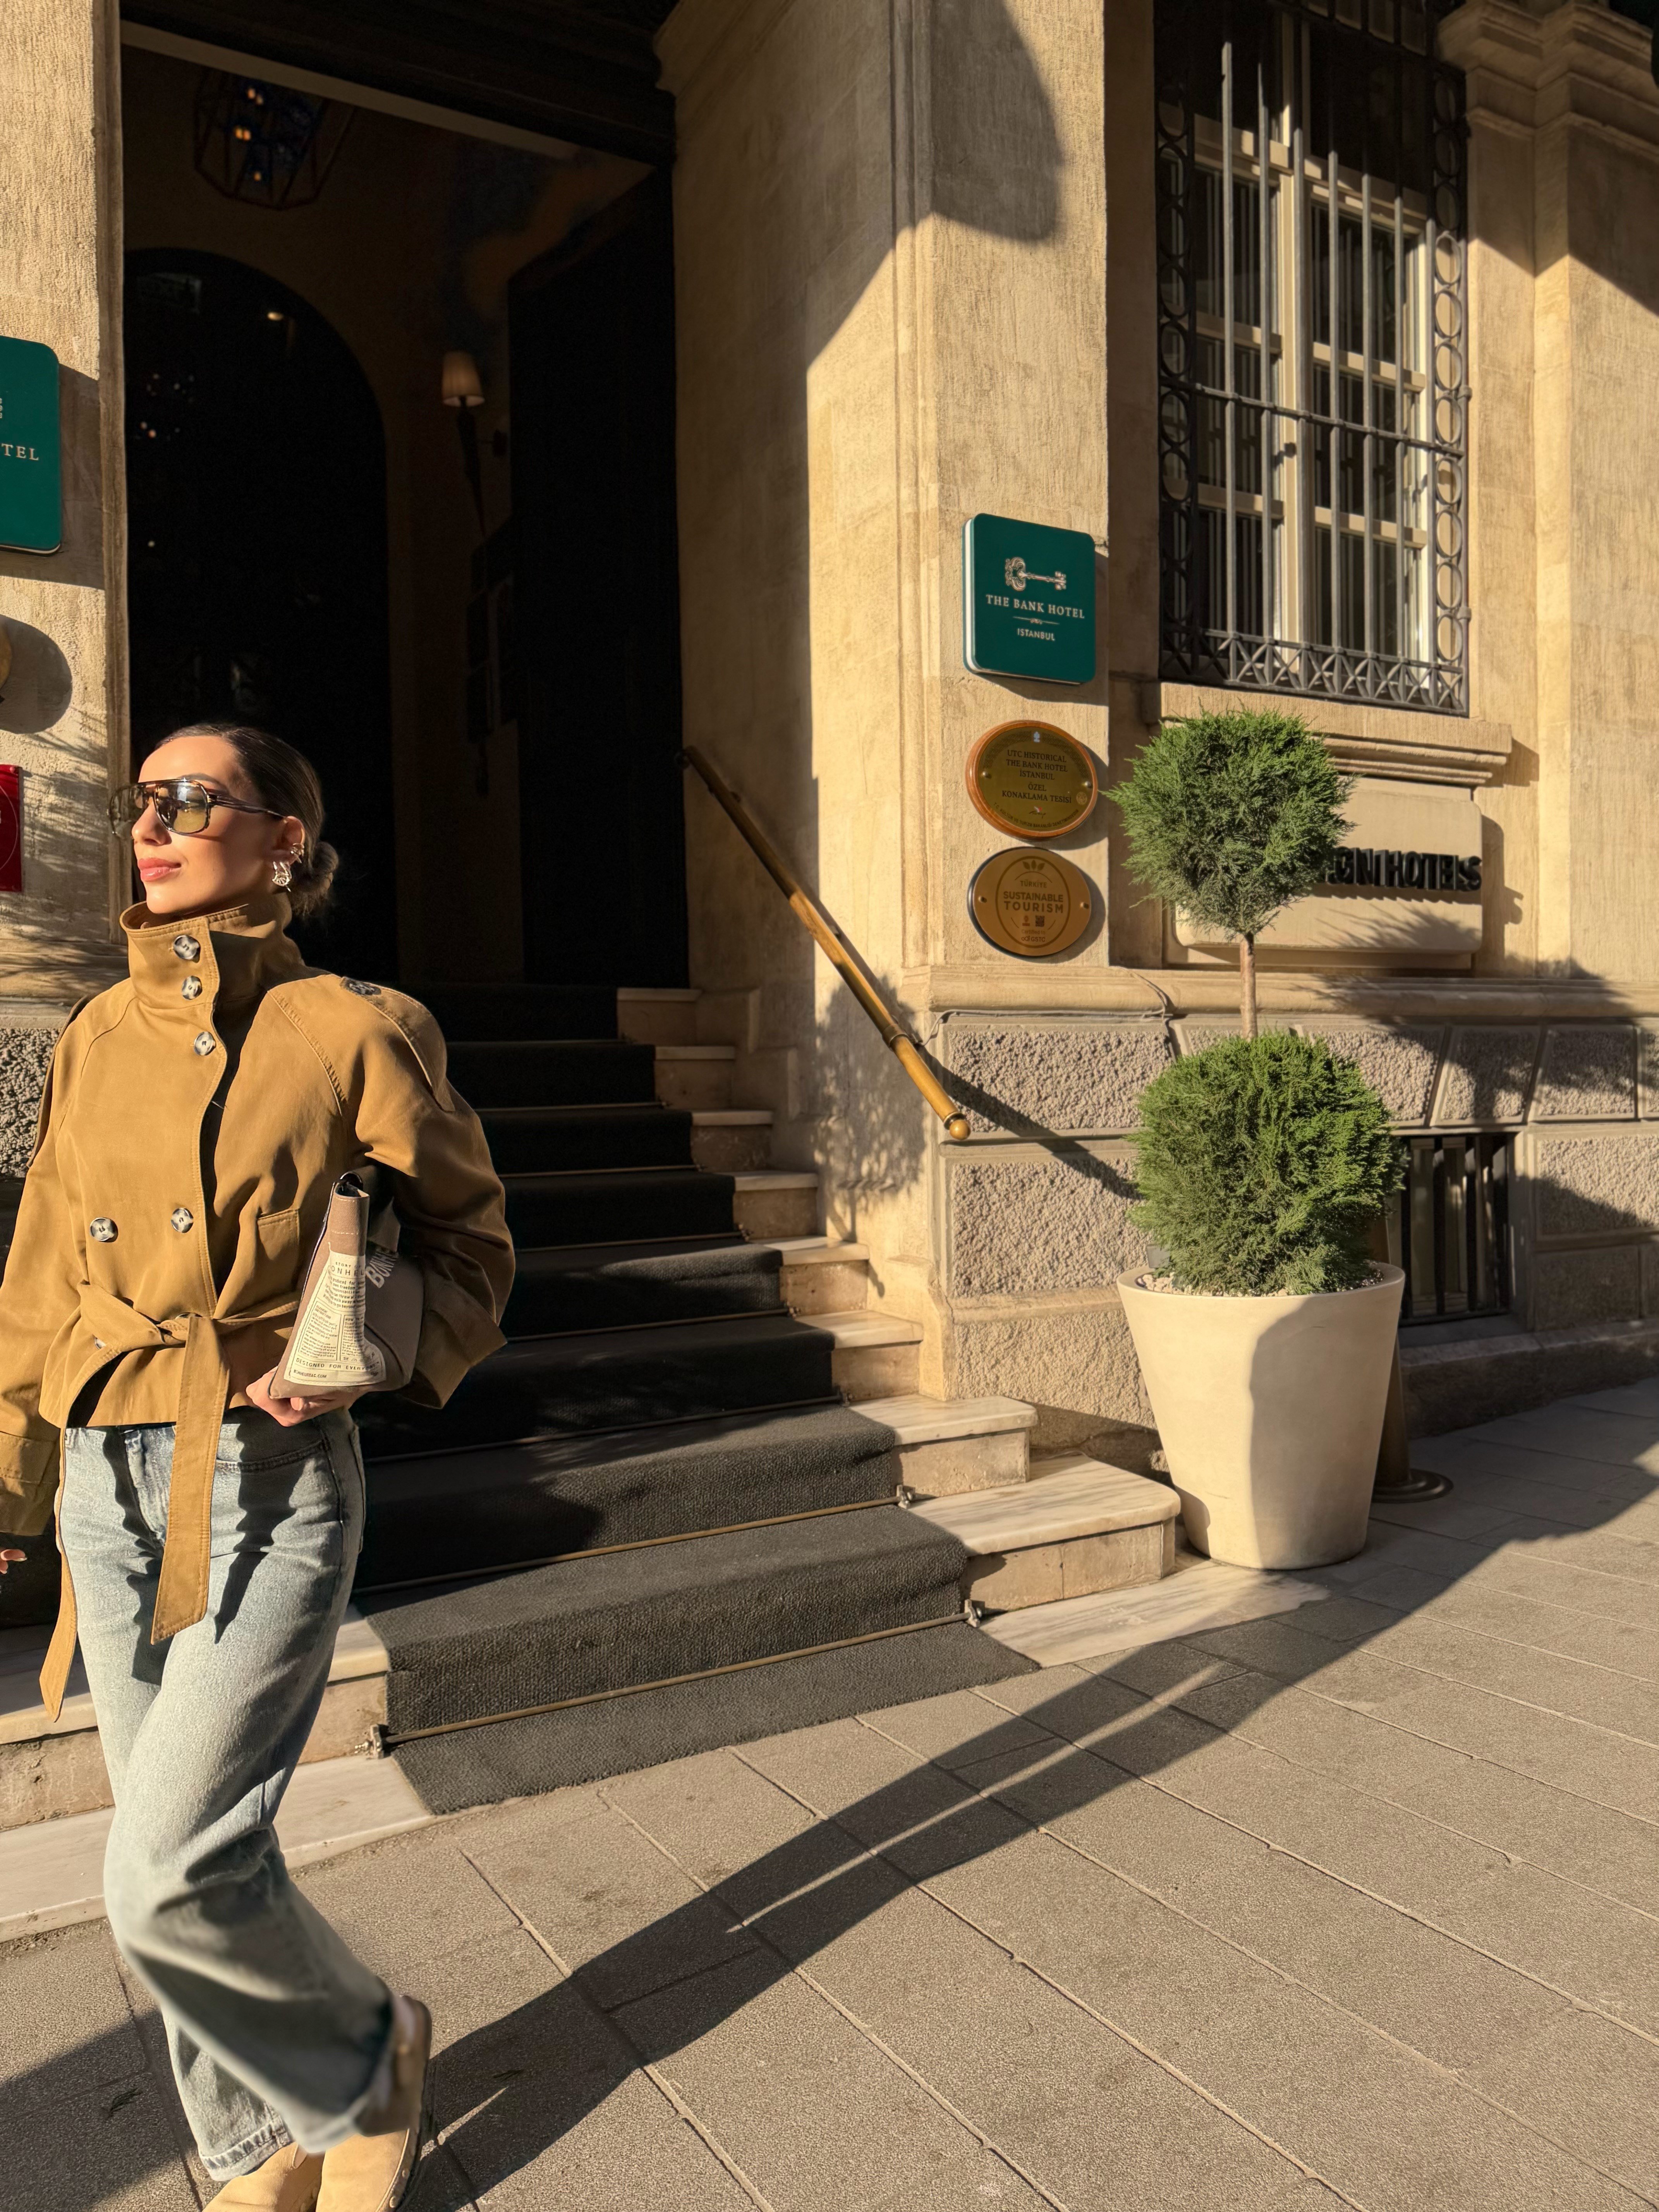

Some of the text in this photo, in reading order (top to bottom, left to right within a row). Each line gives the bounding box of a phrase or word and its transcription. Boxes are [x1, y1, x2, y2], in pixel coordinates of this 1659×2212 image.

[2, 443, 39, 460] TEL
[986, 594, 1084, 618] THE BANK HOTEL
[1017, 628, 1055, 641] ISTANBUL
[1007, 749, 1066, 763] UTC HISTORICAL
[1022, 761, 1042, 769] BANK
[1045, 763, 1068, 772] HOTEL
[1020, 768, 1055, 780] İSTANBUL
[1028, 781, 1046, 791] ÖZEL
[1002, 790, 1072, 803] KONAKLAMA TESİSİ
[1020, 879, 1047, 888] TÜRKİYE
[1003, 891, 1063, 902] SUSTAINABLE
[1003, 901, 1063, 913] TOURISM
[296, 1358, 325, 1368] DESIGNED
